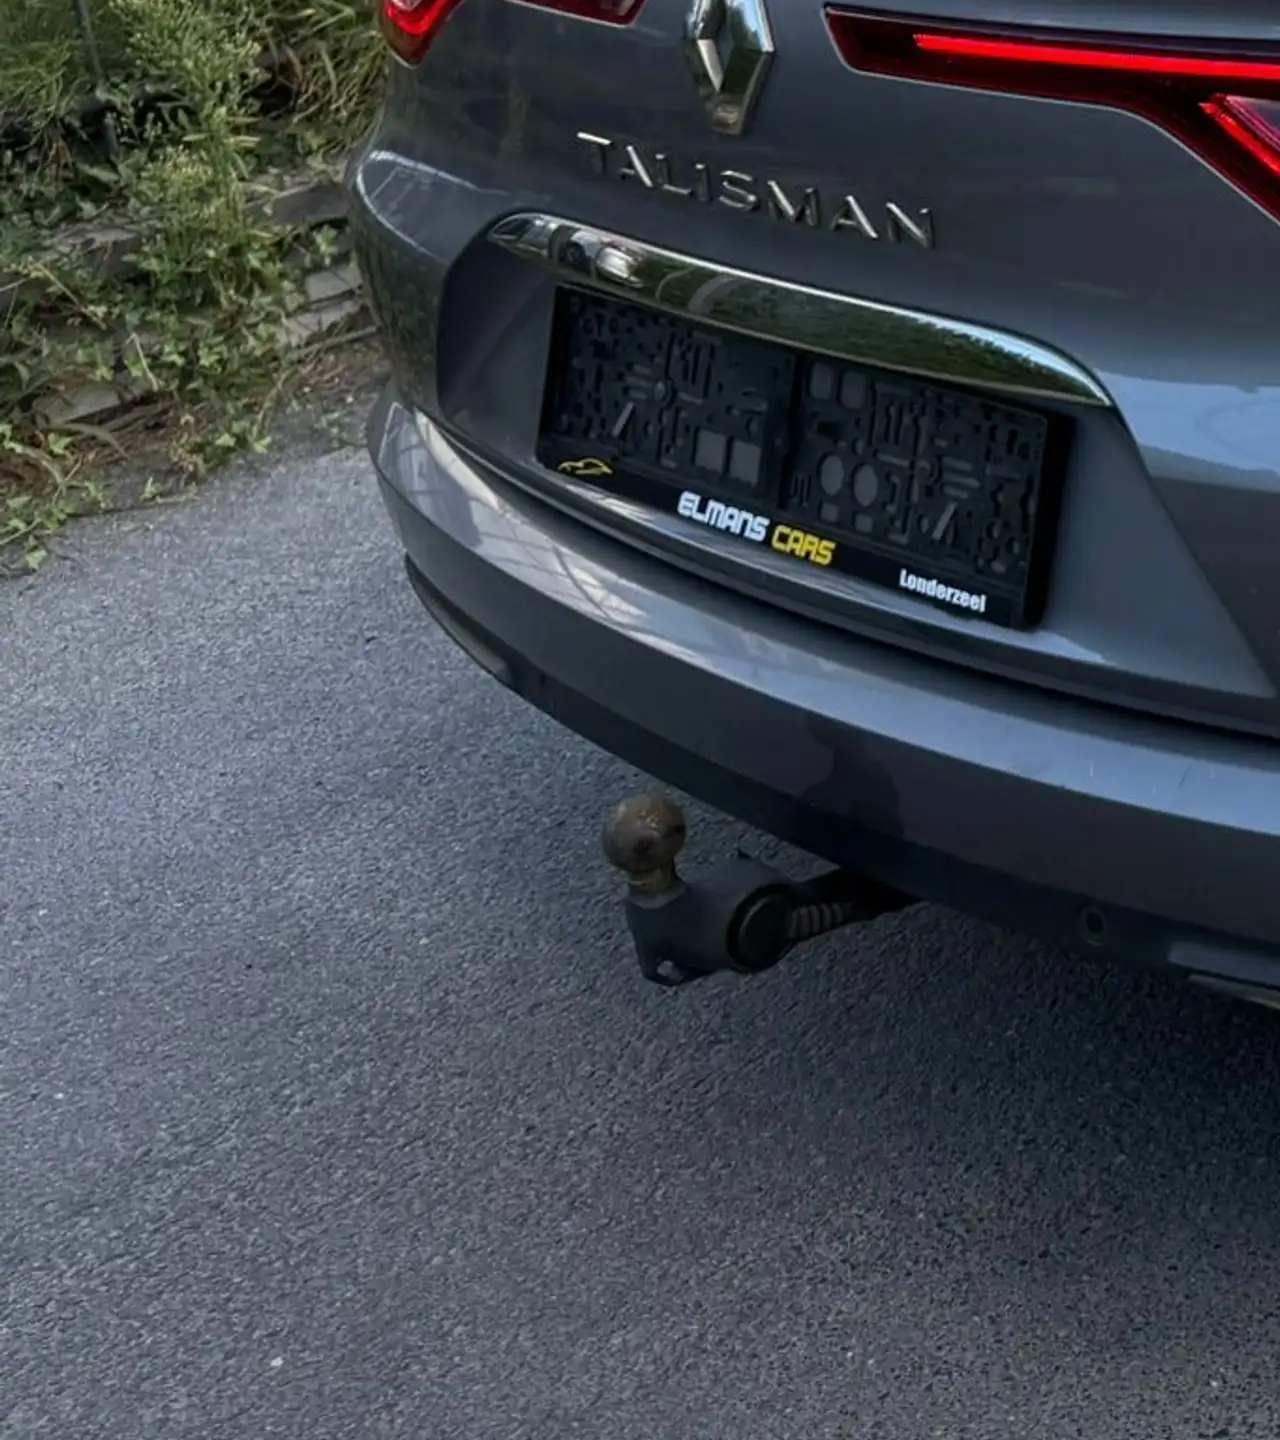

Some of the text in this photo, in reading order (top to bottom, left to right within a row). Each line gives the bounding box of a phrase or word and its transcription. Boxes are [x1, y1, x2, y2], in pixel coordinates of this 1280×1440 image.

[577, 131, 935, 249] TALISMAN
[677, 491, 836, 566] ELMANS CARS
[899, 568, 987, 613] Londerzeel
